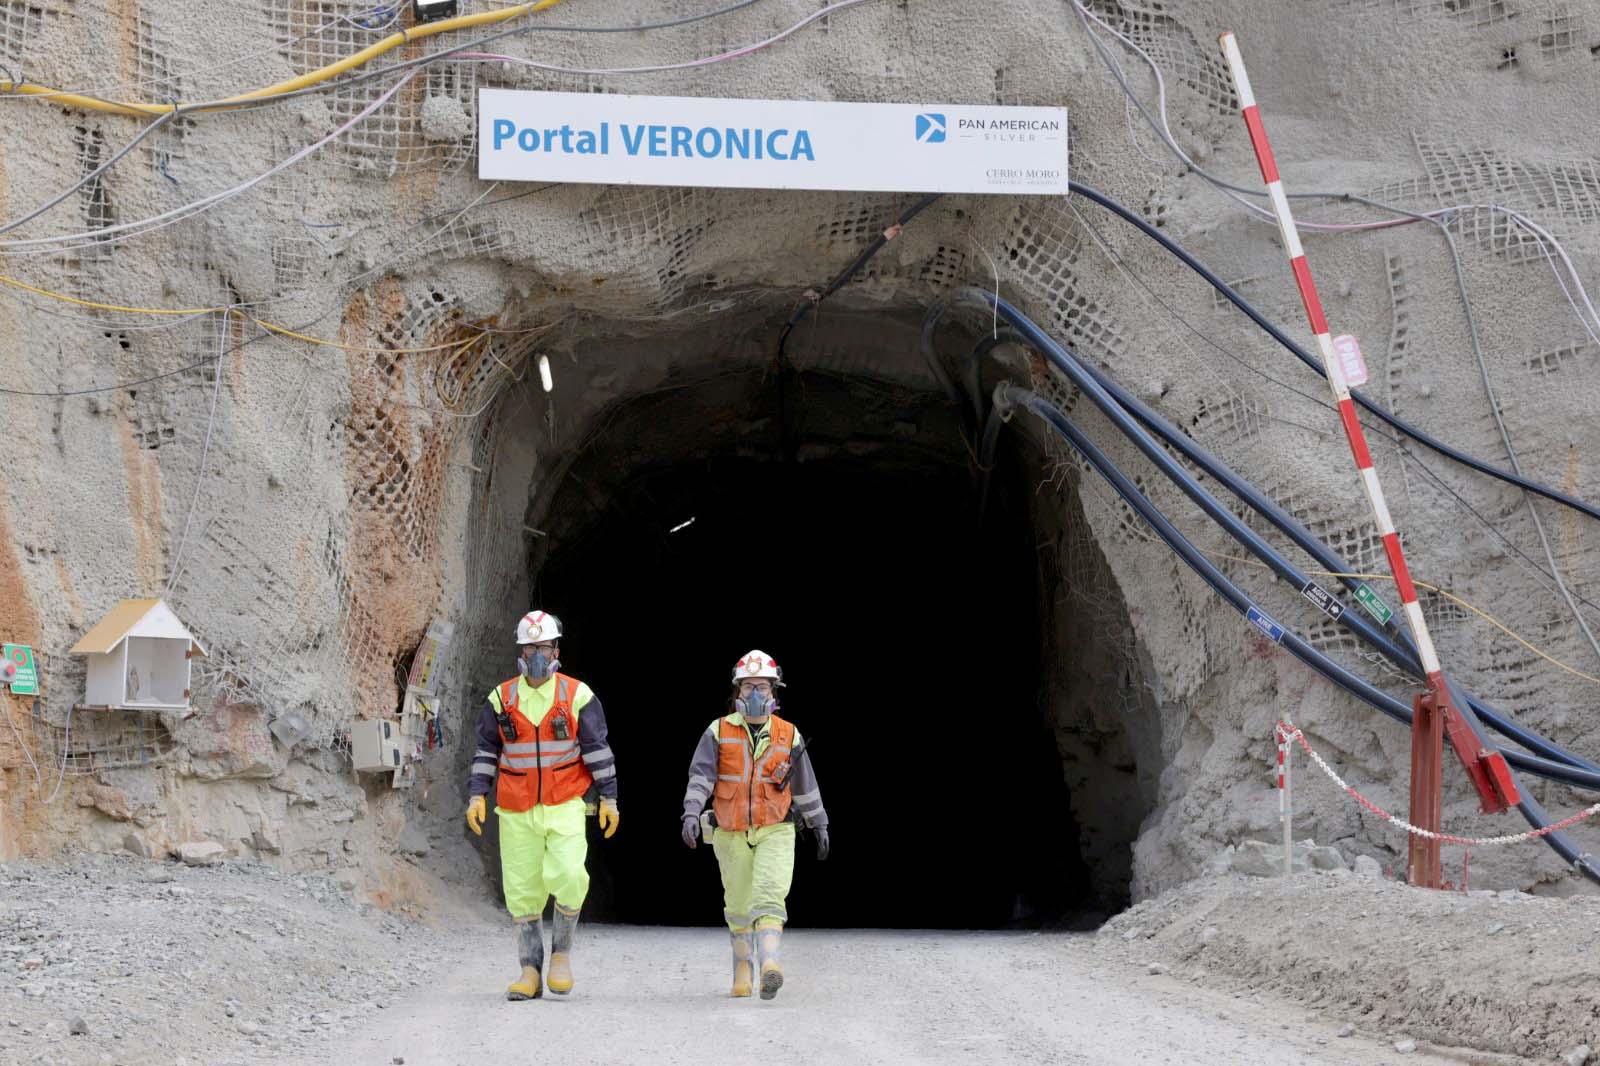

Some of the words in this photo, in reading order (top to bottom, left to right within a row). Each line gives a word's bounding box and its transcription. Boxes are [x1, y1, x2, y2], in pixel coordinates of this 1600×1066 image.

[959, 119, 985, 129] PAN
[989, 120, 1059, 130] AMERICAN
[493, 119, 609, 154] Portal
[620, 124, 815, 161] VERONICA
[984, 133, 1036, 142] SILVER
[985, 169, 1023, 179] CERRO
[1026, 169, 1060, 179] MORO
[1311, 586, 1328, 602] AGUA
[1370, 598, 1386, 615] AGUA
[1257, 616, 1273, 630] AIRE
